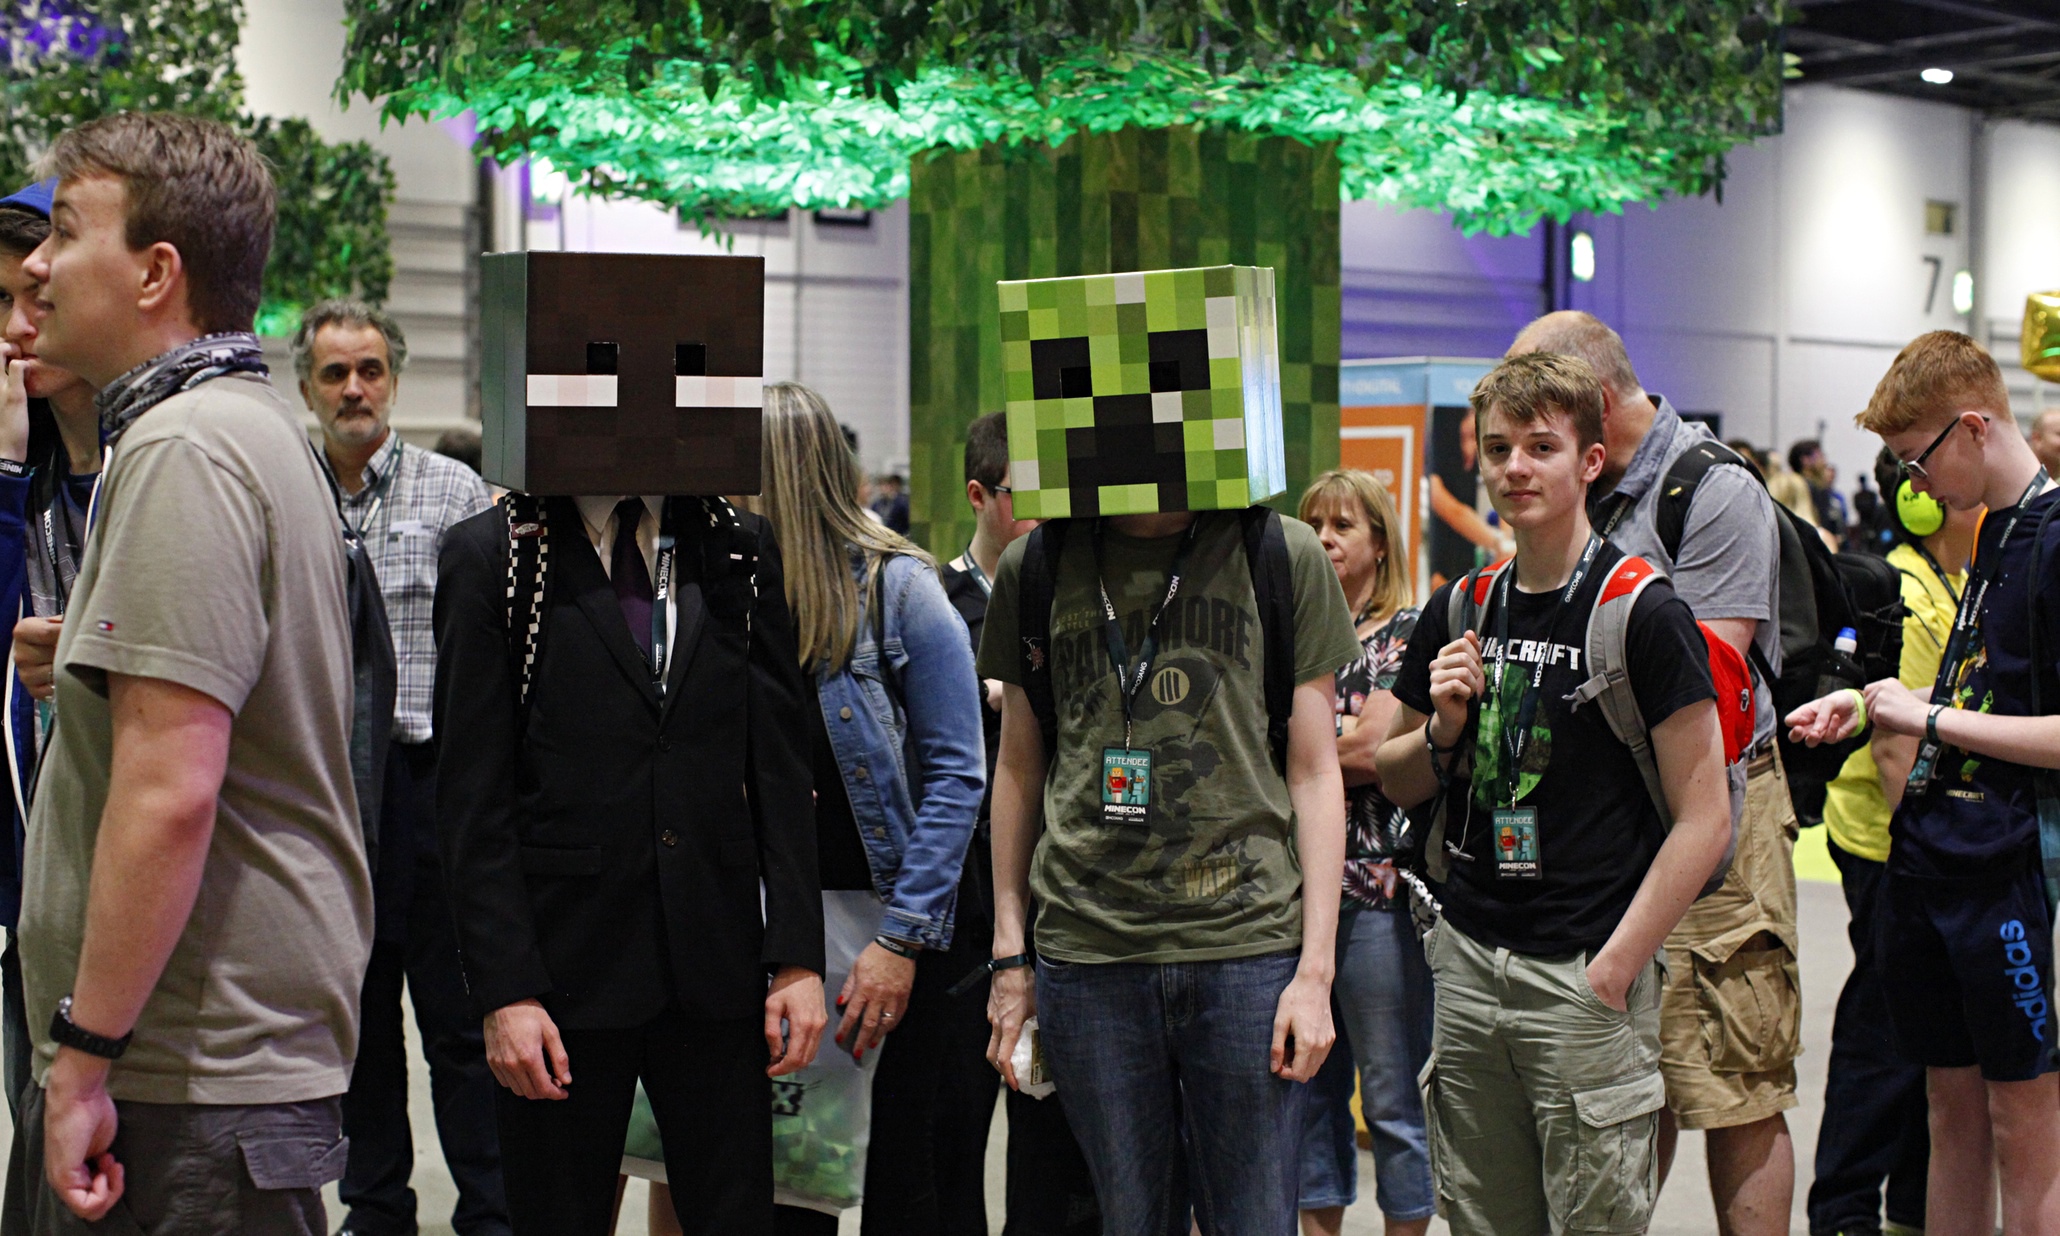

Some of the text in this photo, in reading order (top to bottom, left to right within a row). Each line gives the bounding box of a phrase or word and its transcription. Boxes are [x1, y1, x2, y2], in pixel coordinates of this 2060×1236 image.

[1921, 255, 1942, 314] 7
[43, 508, 57, 565] MINECON
[657, 551, 671, 600] MINECON
[1564, 574, 1582, 603] MOJANG
[1968, 579, 1989, 626] MINECON
[1105, 756, 1148, 766] ATTENDEE
[1104, 804, 1146, 815] MINECON
[1495, 816, 1533, 825] ATTENDEE
[1499, 862, 1536, 870] MINECON
[2000, 920, 2047, 1041] adidas
